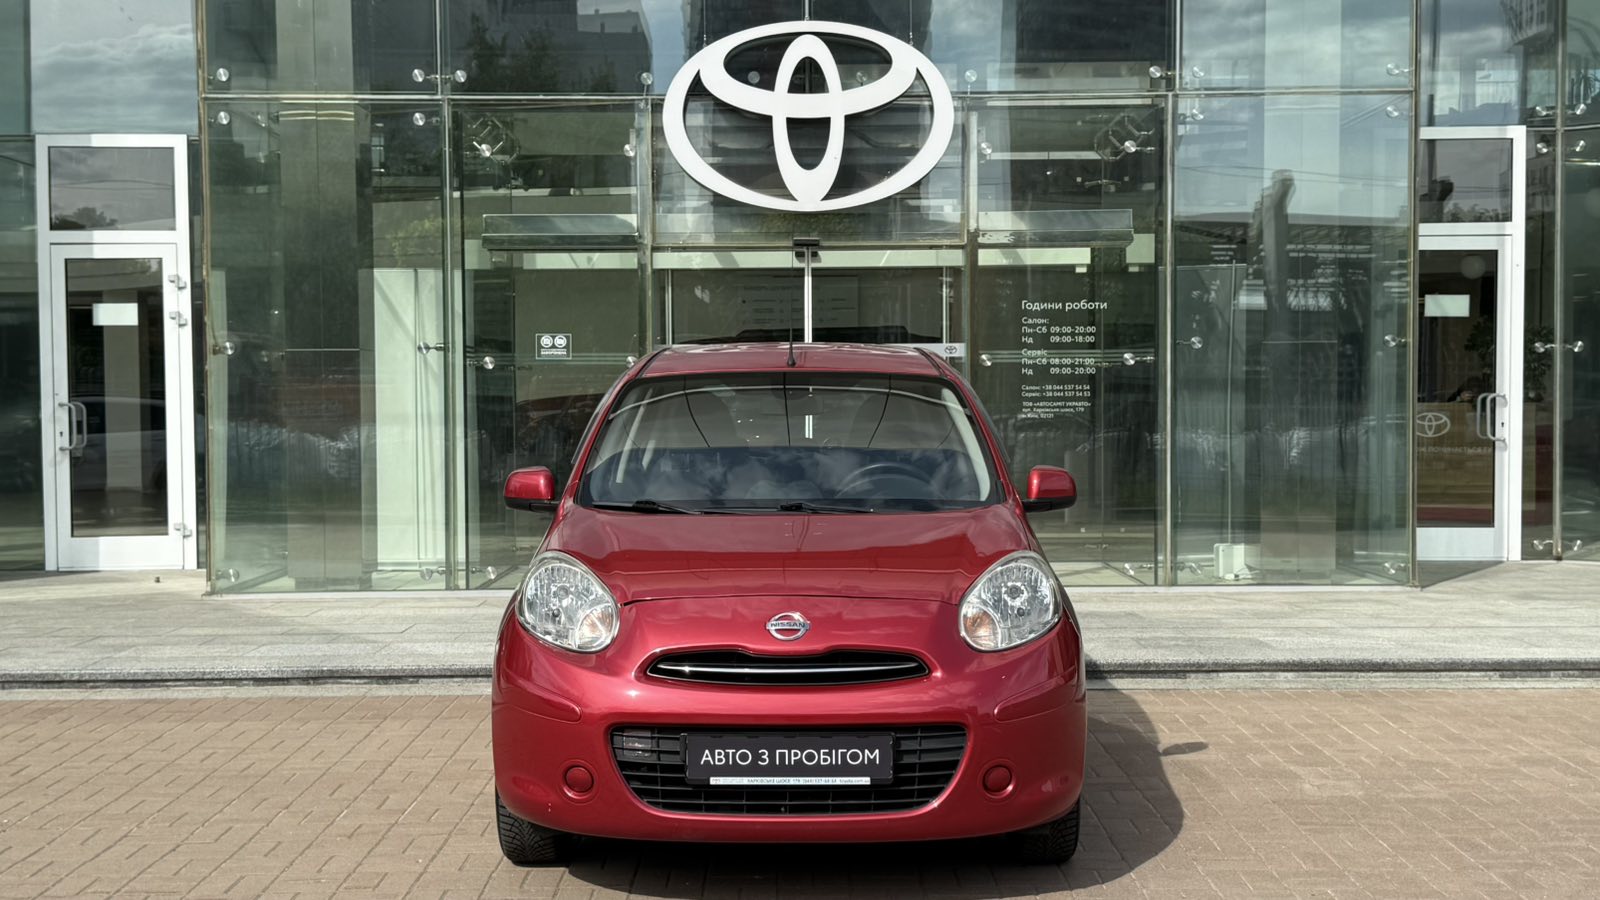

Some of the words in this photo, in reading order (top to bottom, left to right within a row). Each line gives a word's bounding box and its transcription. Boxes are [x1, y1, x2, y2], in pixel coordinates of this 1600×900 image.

[1021, 300, 1062, 311] Години
[1065, 299, 1108, 312] роботи
[1021, 316, 1049, 324] Салон:
[1021, 336, 1033, 344] Нд
[1021, 367, 1033, 375] Нд
[769, 621, 807, 629] NISSAN
[700, 749, 752, 765] АВТО
[775, 749, 880, 765] ПРОБІГОМ
